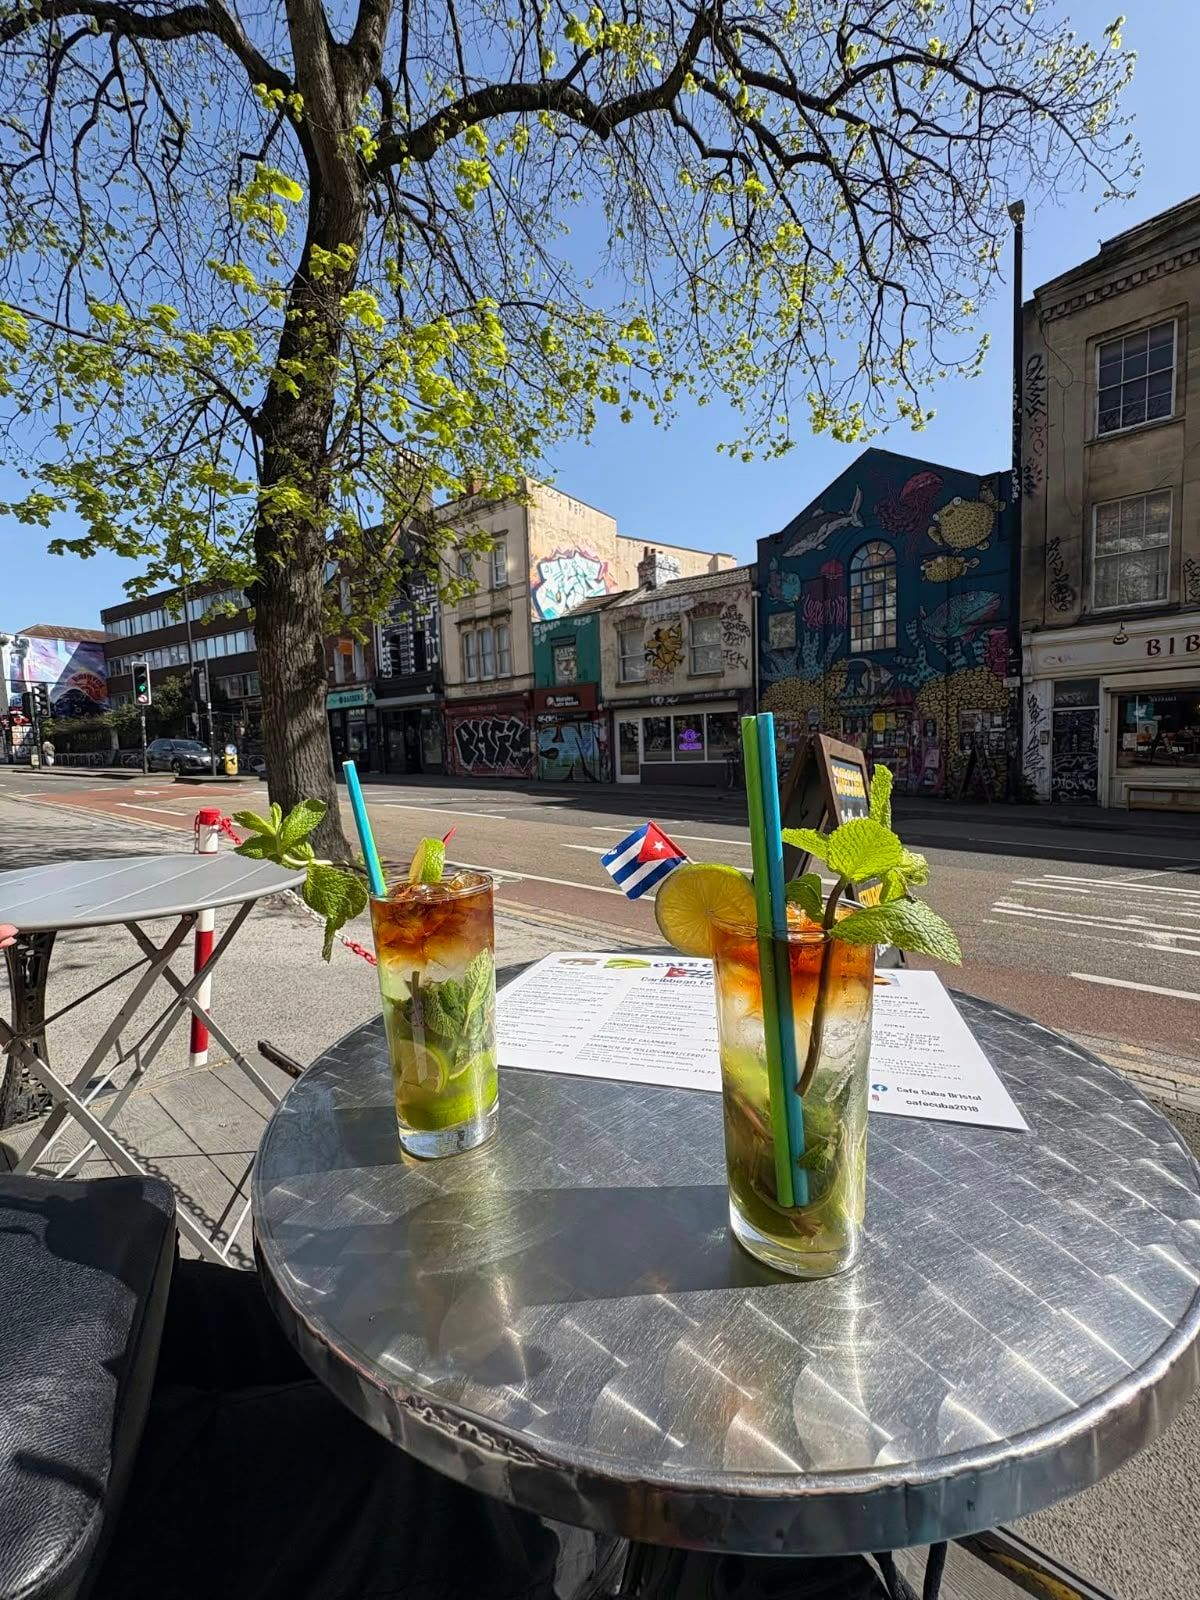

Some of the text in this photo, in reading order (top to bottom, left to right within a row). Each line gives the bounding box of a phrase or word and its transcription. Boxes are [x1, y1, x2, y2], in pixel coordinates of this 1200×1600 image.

[641, 976, 697, 984] Caribbean
[896, 1086, 982, 1101] Cafe Cuba Bristol
[905, 1098, 980, 1113] cafecuba2018
